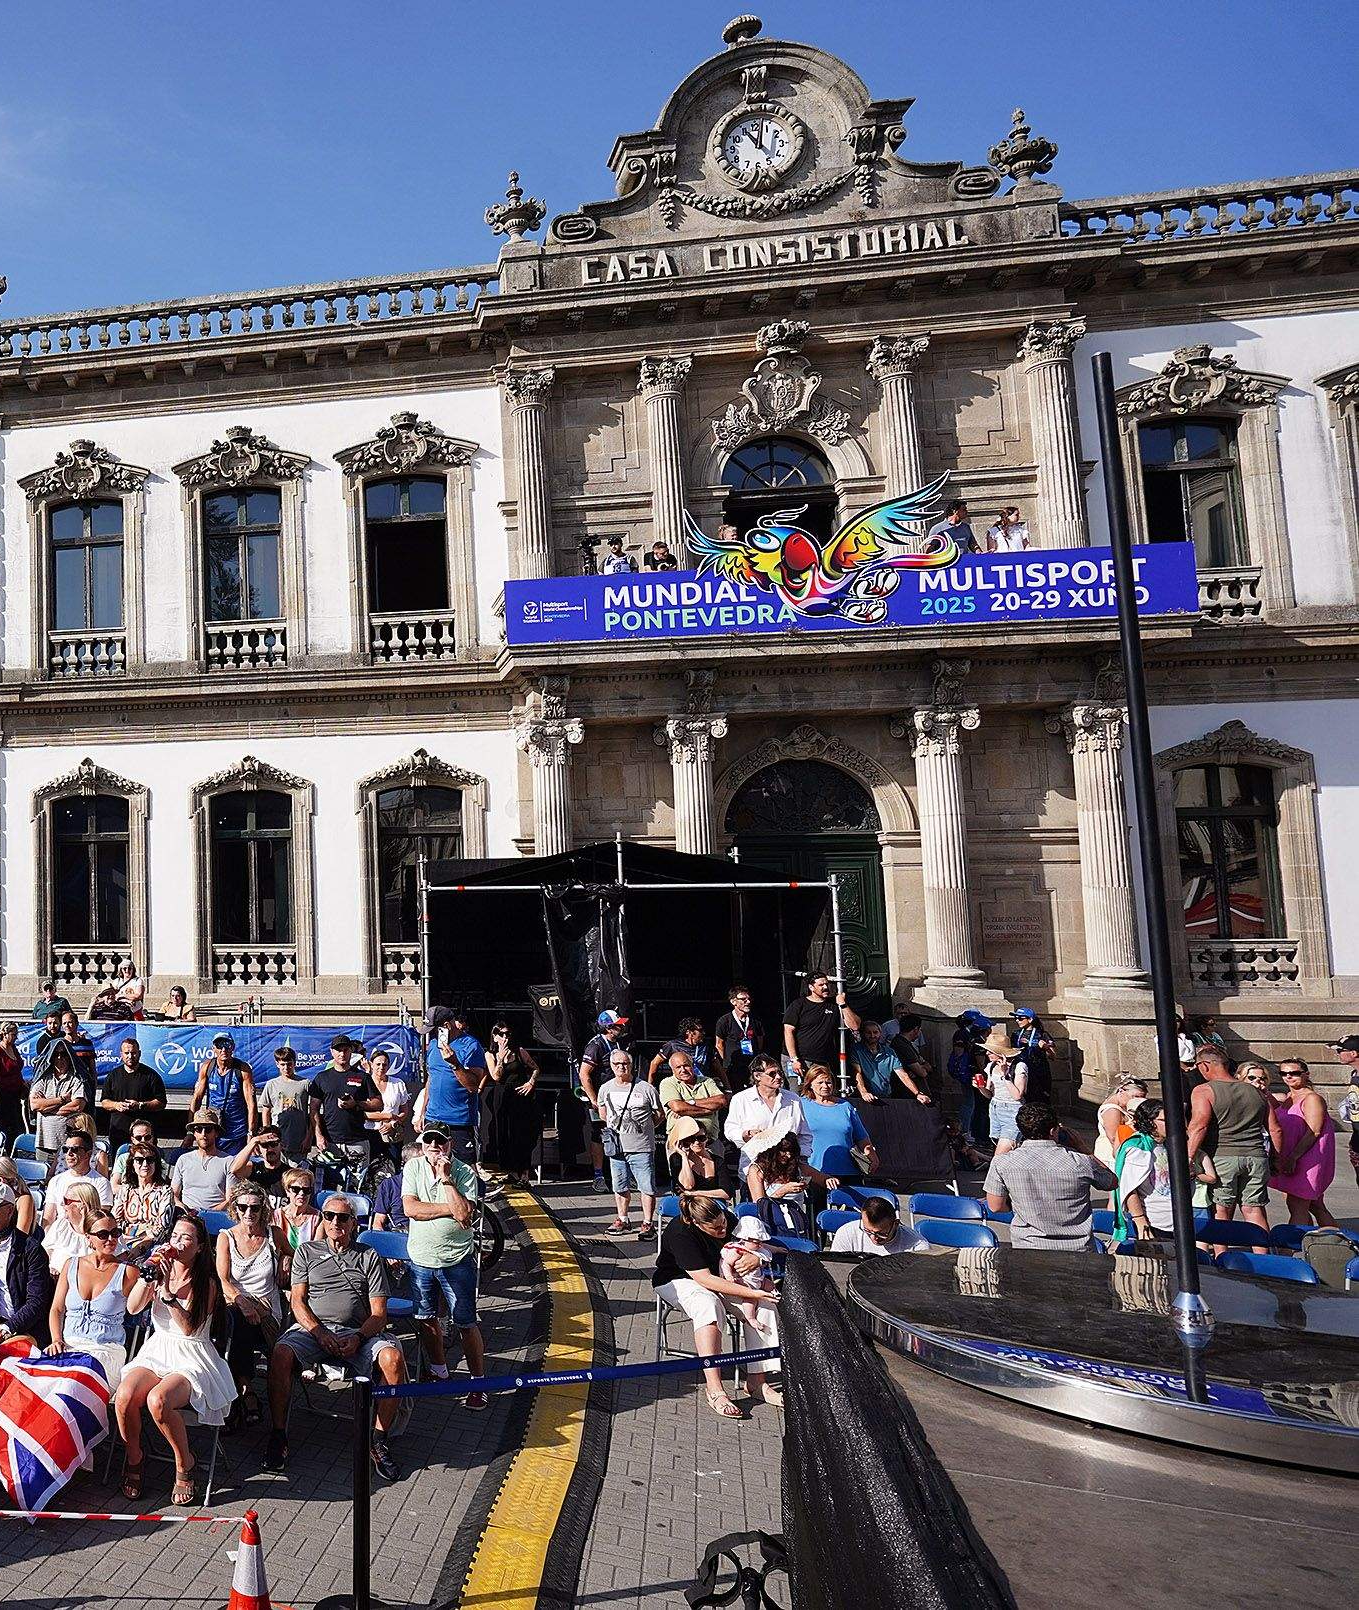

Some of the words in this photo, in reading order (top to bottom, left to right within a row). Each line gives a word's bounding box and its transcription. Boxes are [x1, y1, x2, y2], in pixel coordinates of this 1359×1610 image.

[751, 123, 759, 131] 12
[774, 130, 780, 138] 2
[732, 135, 740, 143] 10
[730, 146, 735, 154] 9
[734, 155, 739, 163] 8
[766, 157, 772, 165] 5
[581, 249, 674, 287] CASA
[703, 219, 969, 273] CONSISTORIAL
[603, 580, 757, 609] MUNDIAL
[604, 604, 797, 632] PONTEVEDRA
[920, 596, 976, 615] 2025
[989, 590, 1061, 612] 20-29
[297, 1052, 308, 1060] Be
[308, 1053, 326, 1062] your
